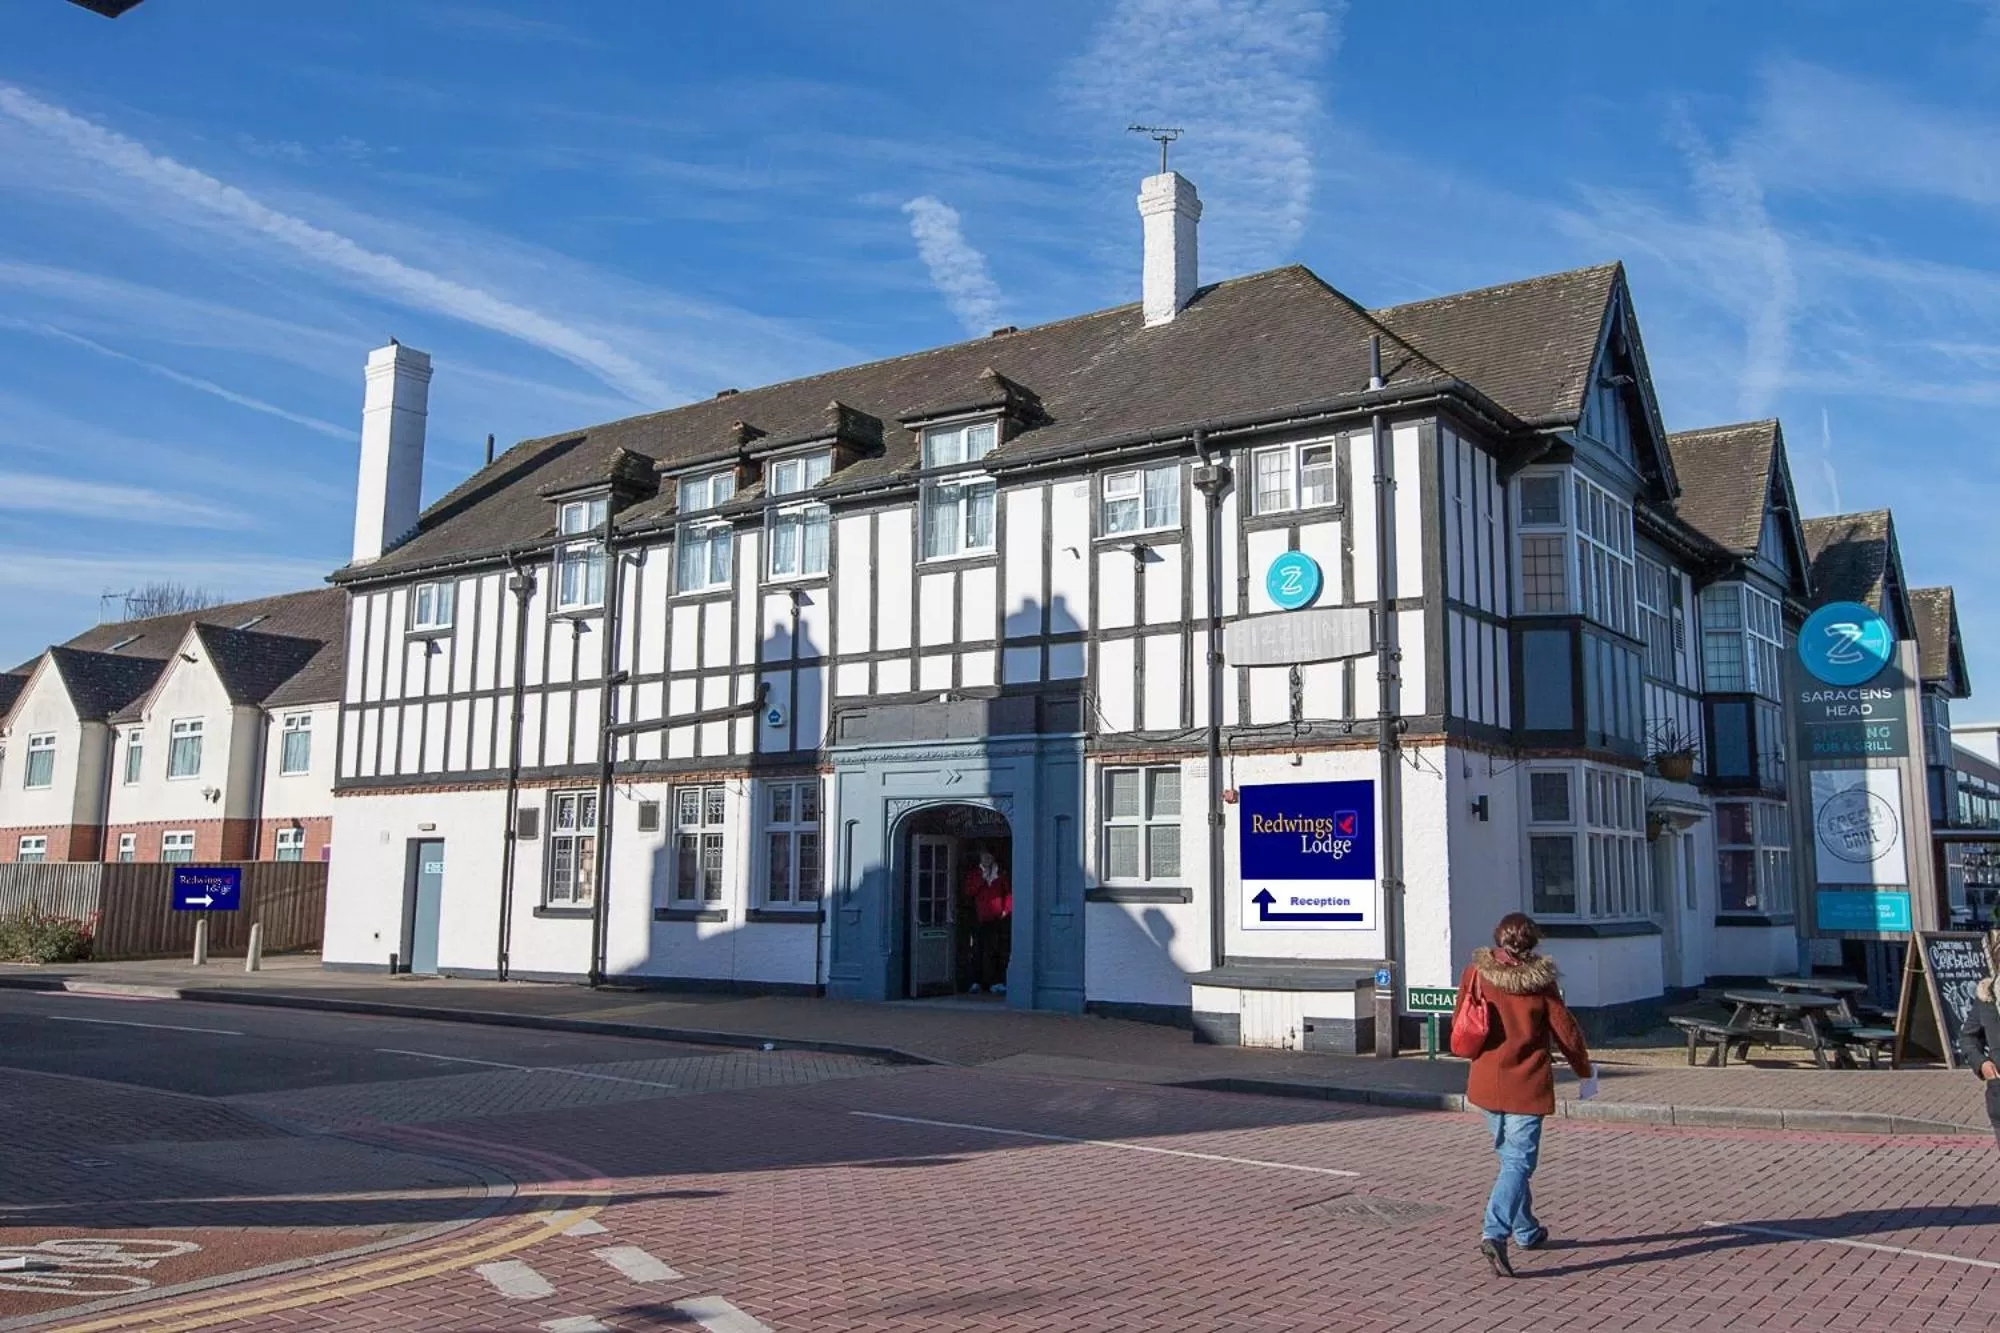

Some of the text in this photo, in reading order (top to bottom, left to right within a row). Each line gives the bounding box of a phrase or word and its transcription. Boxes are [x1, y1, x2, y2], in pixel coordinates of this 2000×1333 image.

[1801, 687, 1893, 703] SARACENS
[1825, 703, 1874, 717] HEAD
[1855, 739, 1892, 751] GRILL
[1252, 812, 1333, 839] Redwings
[1301, 834, 1352, 859] Lodge
[1843, 829, 1881, 849] GRILL
[1290, 896, 1351, 907] Reception
